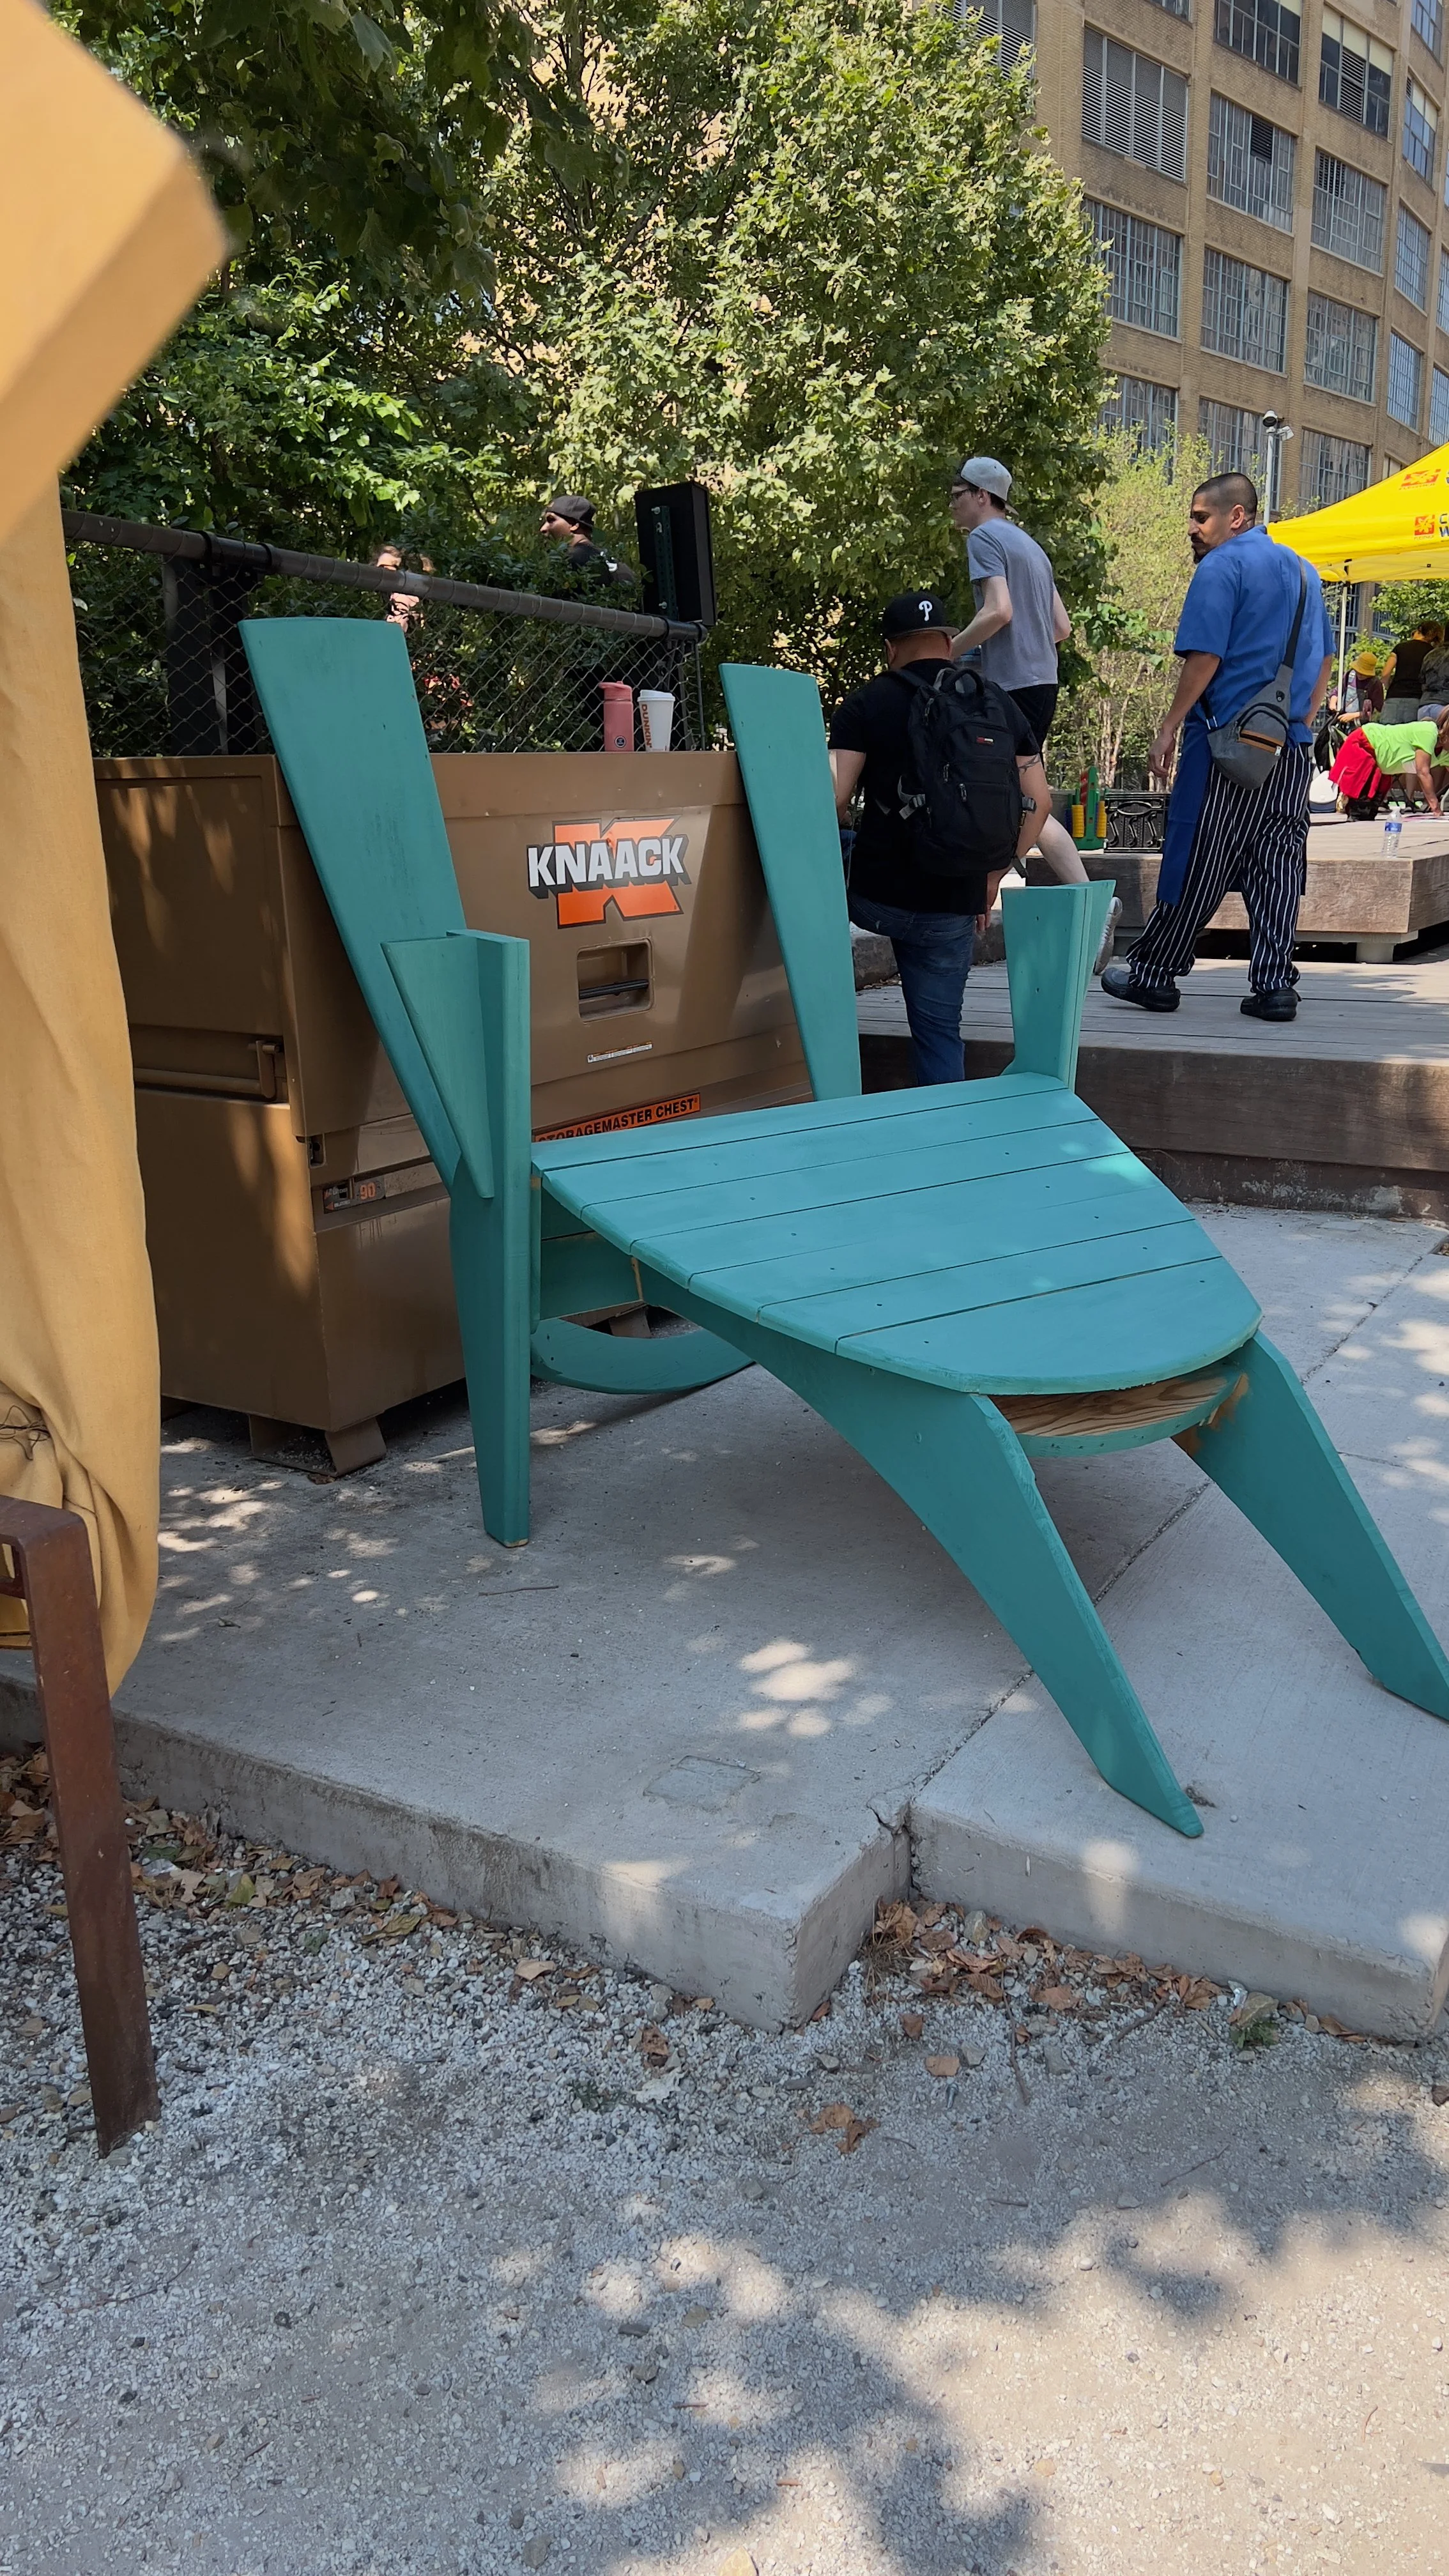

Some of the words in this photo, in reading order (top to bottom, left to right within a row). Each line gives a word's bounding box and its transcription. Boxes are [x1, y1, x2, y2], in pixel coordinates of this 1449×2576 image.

[919, 601, 933, 621] P
[528, 837, 684, 887] KNAACK
[656, 1098, 694, 1117] CHEST
[360, 1182, 376, 1201] 90
